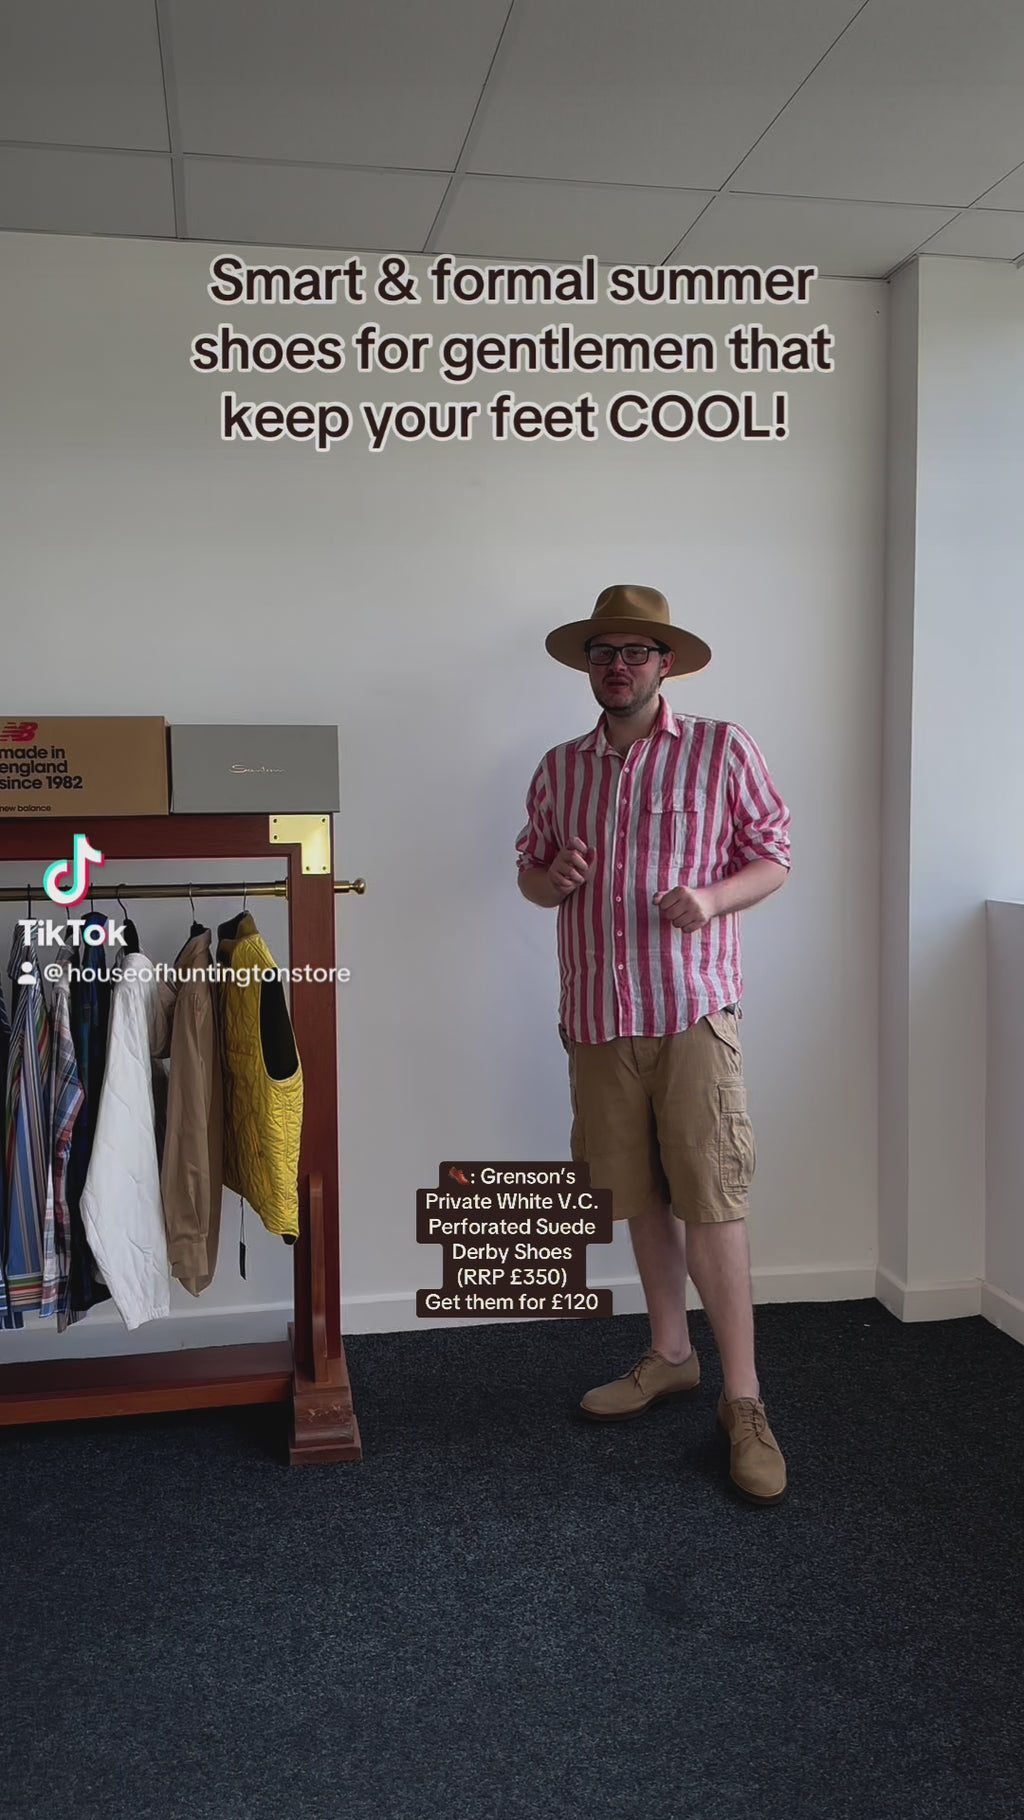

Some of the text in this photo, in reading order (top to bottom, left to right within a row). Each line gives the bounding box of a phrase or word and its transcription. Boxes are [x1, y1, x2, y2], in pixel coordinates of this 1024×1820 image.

[0, 745, 65, 759] made in
[0, 760, 68, 777] england
[0, 775, 83, 790] since 1982
[17, 804, 52, 812] balance
